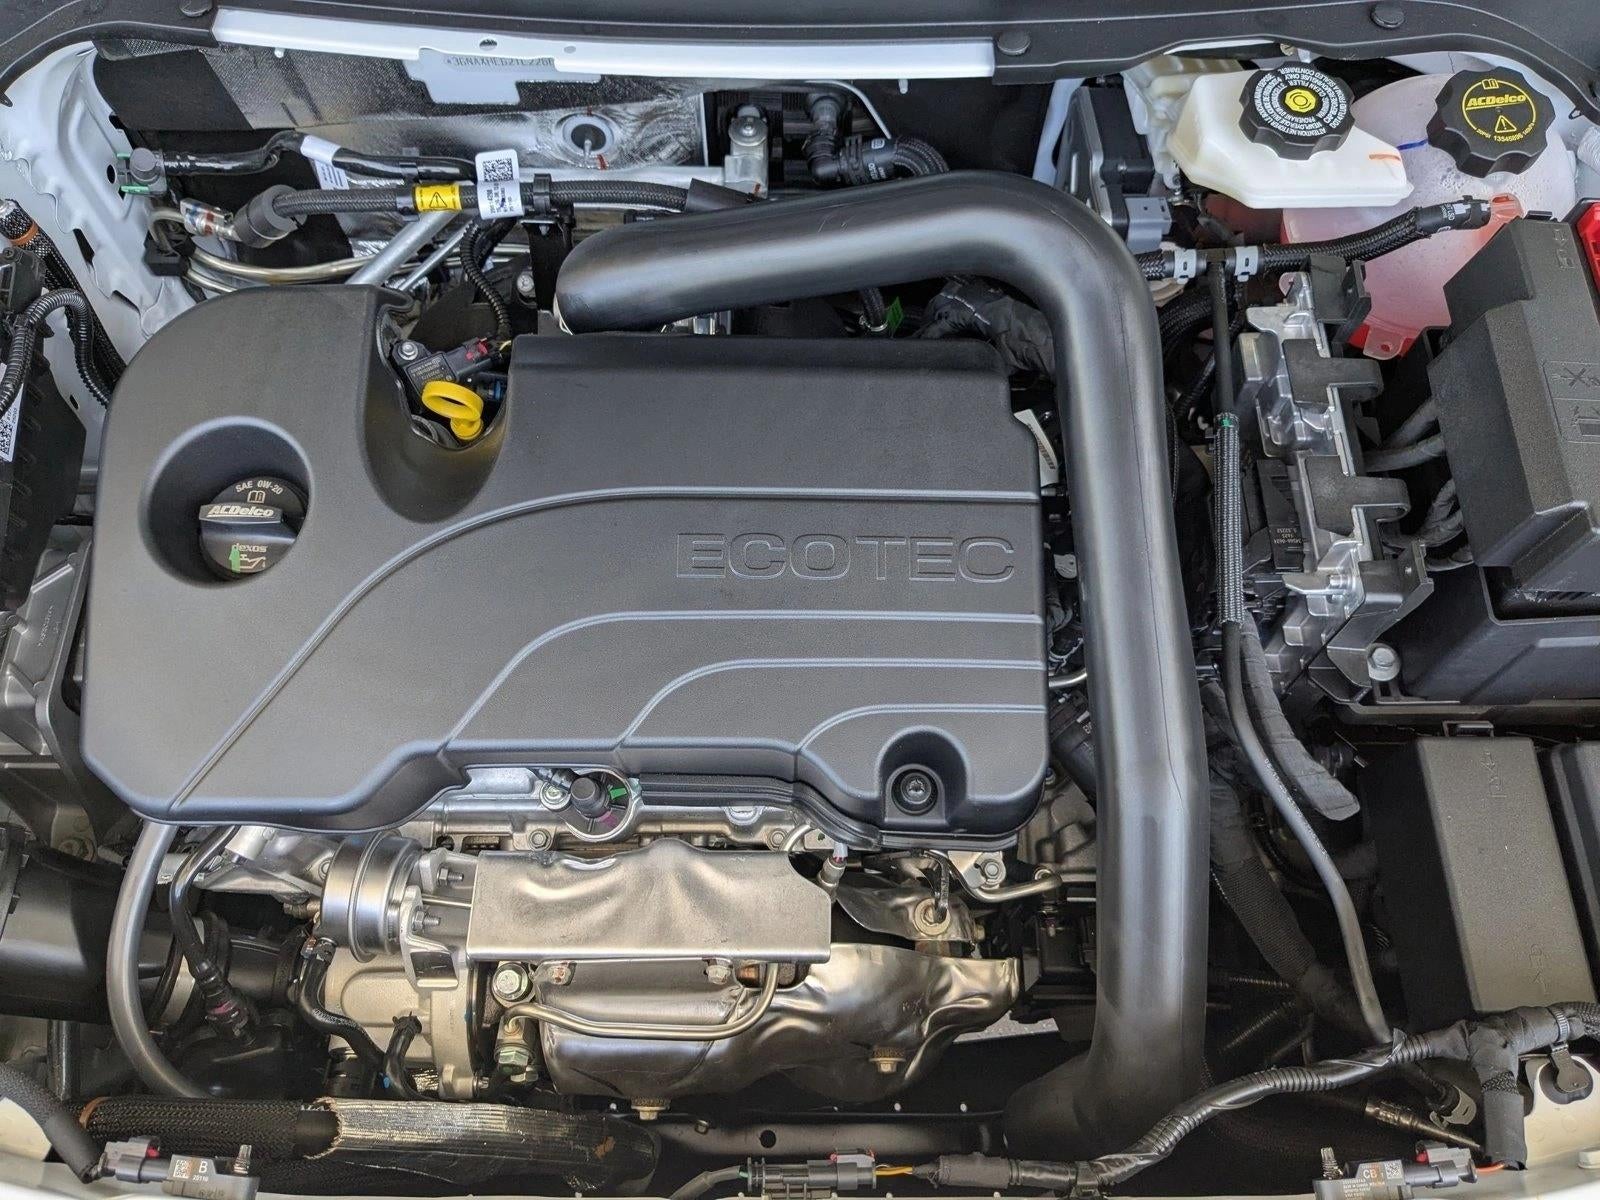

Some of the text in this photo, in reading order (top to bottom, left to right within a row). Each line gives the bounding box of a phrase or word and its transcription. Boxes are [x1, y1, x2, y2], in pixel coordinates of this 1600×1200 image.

[1314, 72, 1337, 87] SEALED
[1466, 94, 1526, 107] ACDelco
[235, 480, 284, 495] SAE 0W-20
[206, 505, 274, 517] ACDelco
[231, 543, 268, 553] dexos
[676, 532, 1016, 584] ECOTEC
